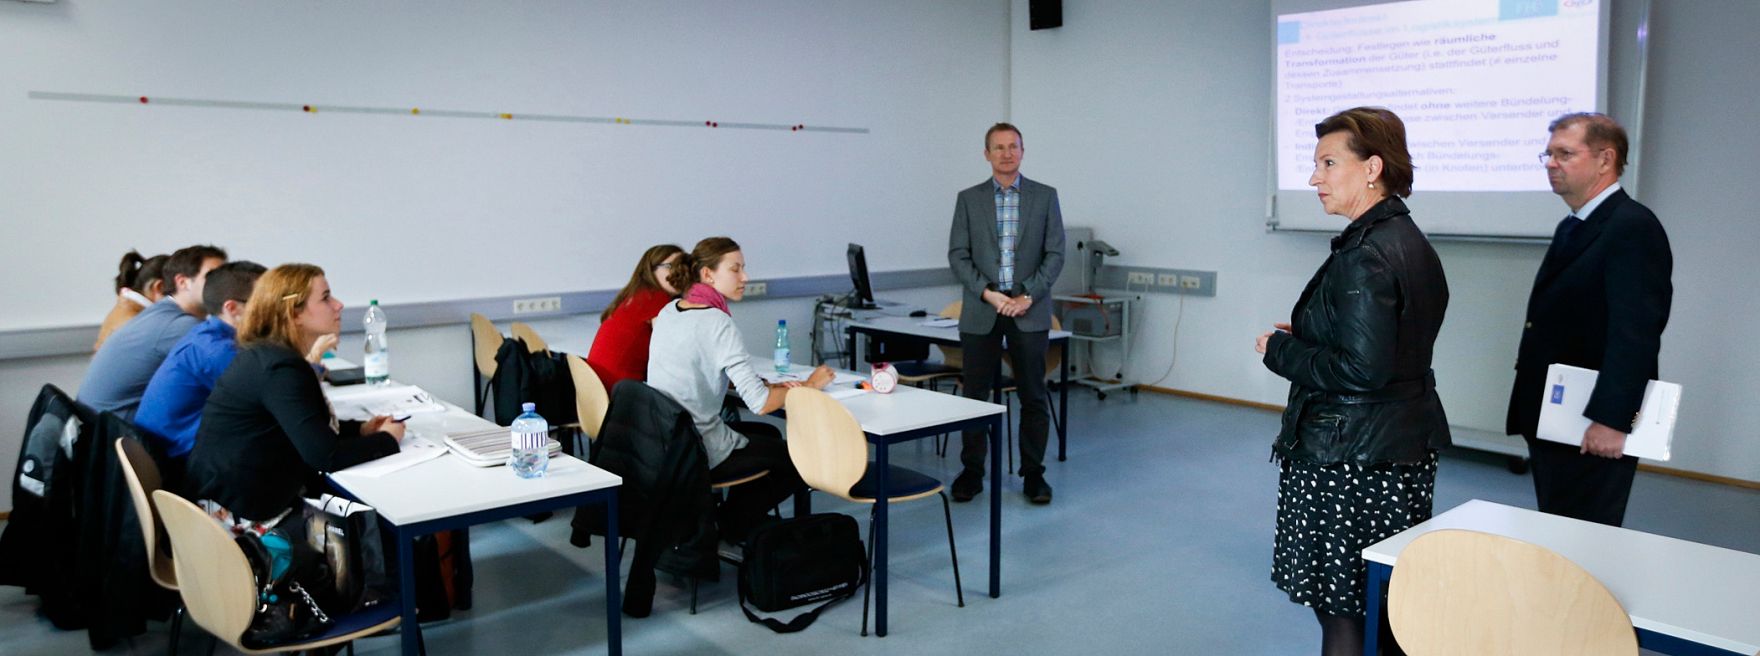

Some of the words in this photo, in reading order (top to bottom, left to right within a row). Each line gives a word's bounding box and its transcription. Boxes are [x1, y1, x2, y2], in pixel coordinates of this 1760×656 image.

[1412, 39, 1431, 47] wie
[1434, 33, 1496, 45] räumliche
[1284, 55, 1366, 68] Transformation
[1368, 54, 1386, 63] der
[1388, 50, 1419, 61] Güter
[1446, 47, 1466, 57] der
[1469, 43, 1533, 55] Güterfluss
[1535, 39, 1560, 50] und
[1428, 57, 1487, 70] stattfindet
[1504, 52, 1558, 65] einzelne
[1420, 101, 1450, 111] ohne
[1454, 98, 1497, 109] weitere
[1480, 108, 1545, 121] Versender
[1407, 137, 1455, 149] wischen
[1458, 137, 1521, 149] Versender
